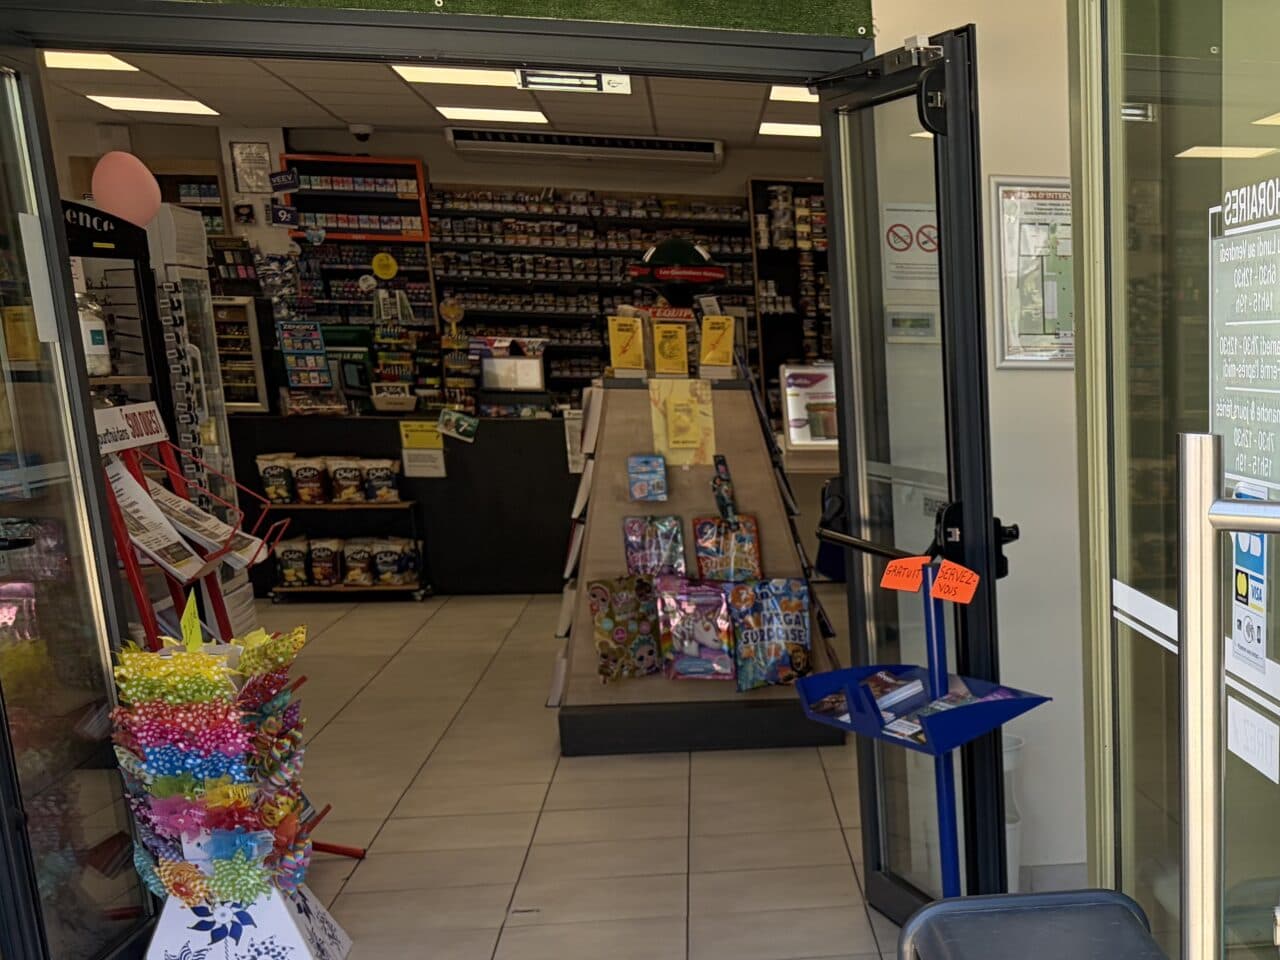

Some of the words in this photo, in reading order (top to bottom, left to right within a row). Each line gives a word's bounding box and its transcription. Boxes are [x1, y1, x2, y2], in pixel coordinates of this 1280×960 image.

[885, 565, 923, 579] GRATUIT
[937, 564, 977, 586] SERVEZ-
[937, 582, 958, 596] VOUS
[1250, 584, 1263, 602] VISA
